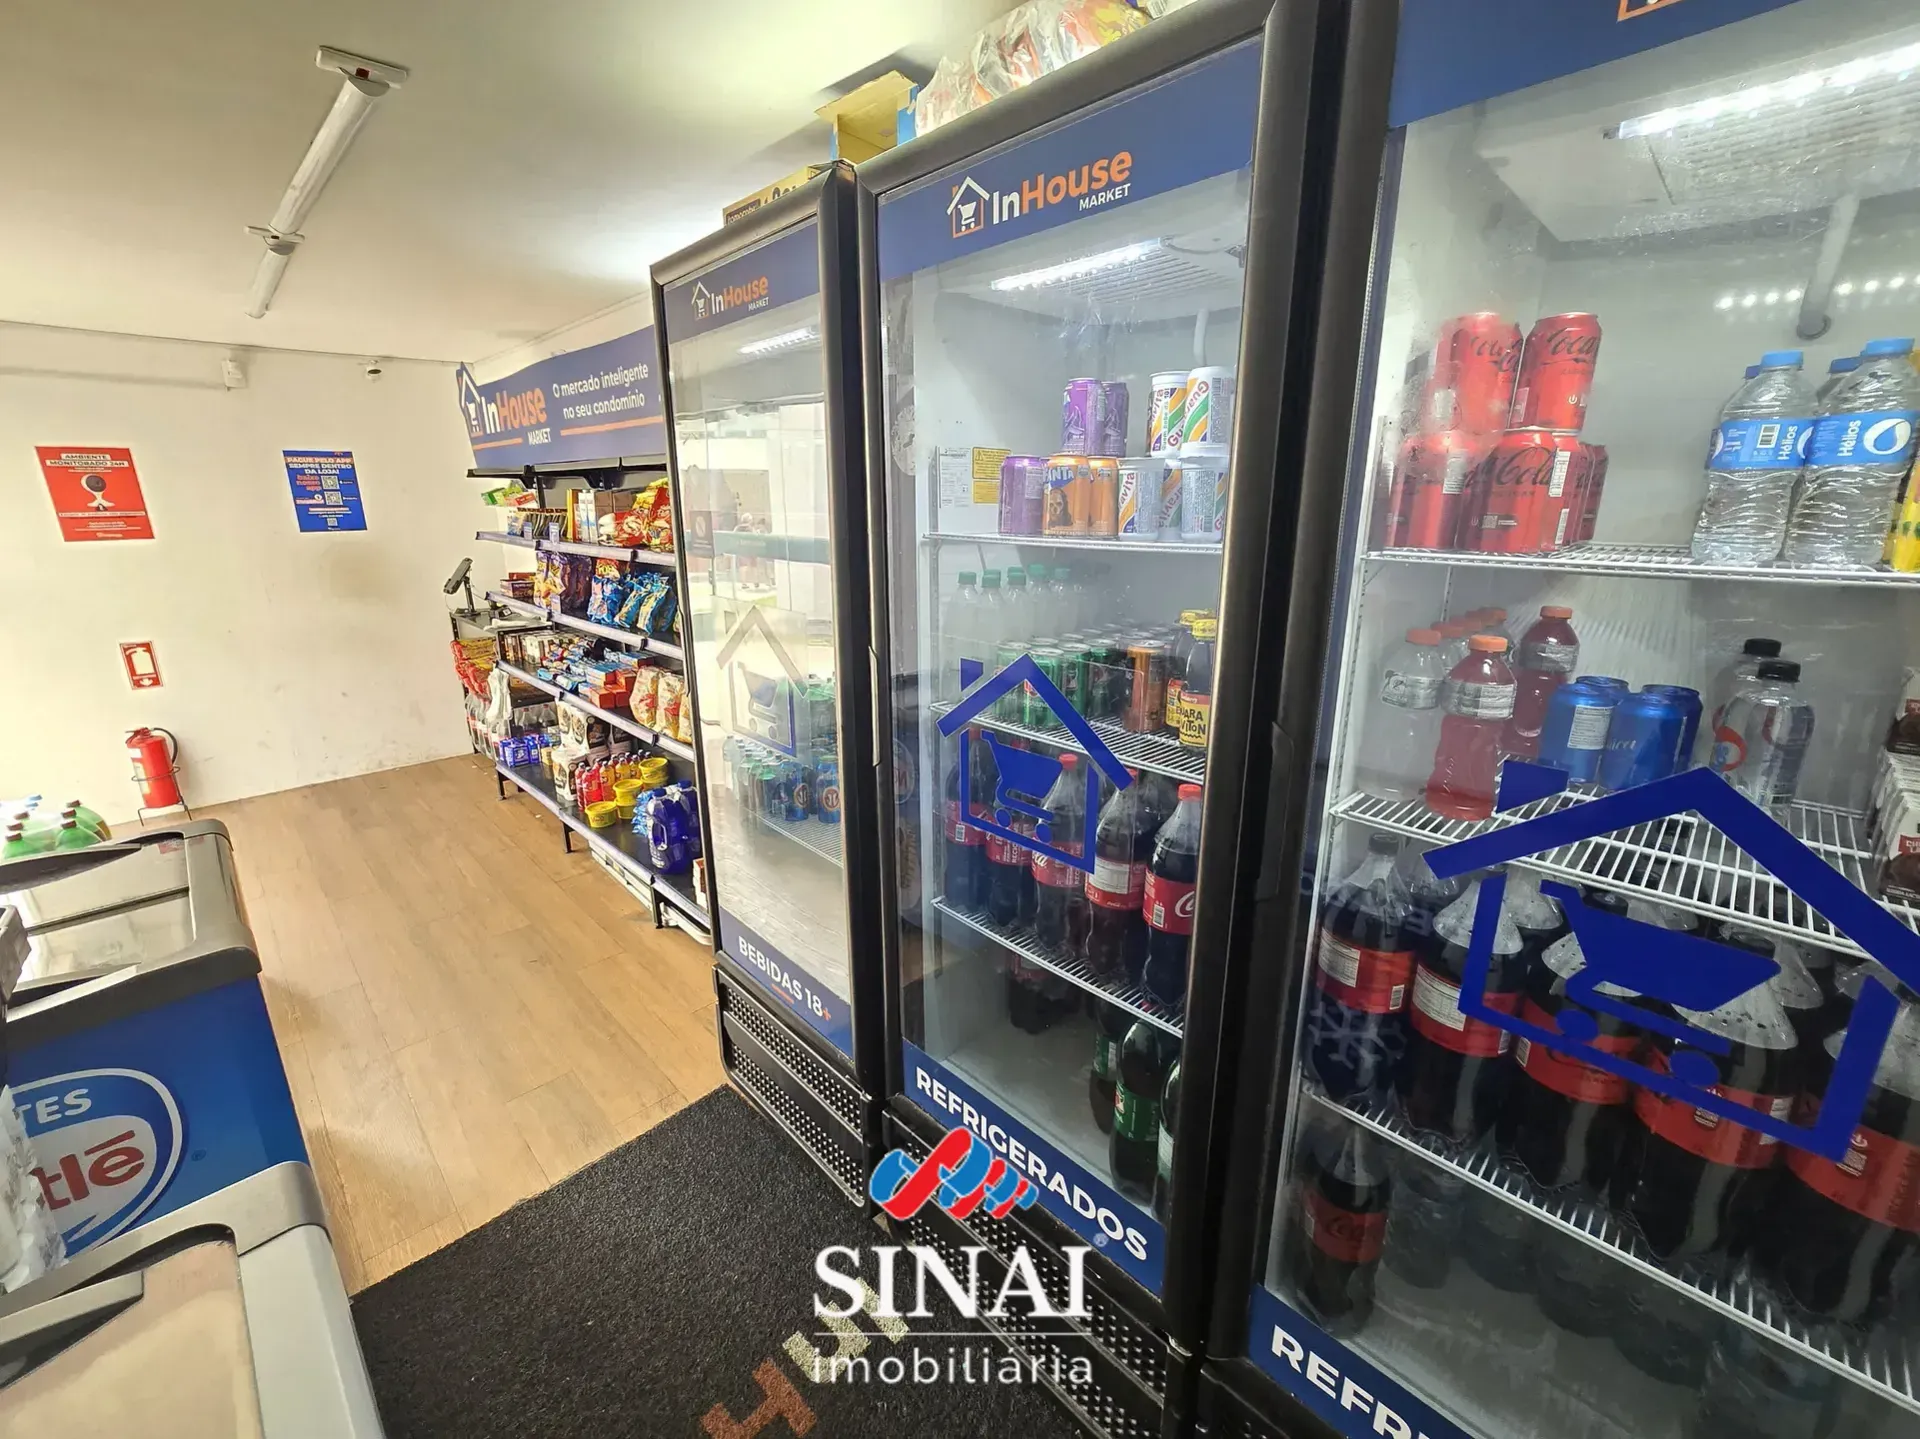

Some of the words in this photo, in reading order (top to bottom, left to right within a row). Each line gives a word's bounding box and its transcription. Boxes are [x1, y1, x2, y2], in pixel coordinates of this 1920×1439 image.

[992, 150, 1133, 225] InHouse
[1078, 183, 1132, 211] MARKET
[711, 276, 769, 315] InHouse
[748, 297, 769, 311] MARKET
[552, 383, 561, 399] O
[561, 374, 600, 398] mercado
[600, 363, 649, 389] inteligente
[481, 388, 548, 435] InHouse
[563, 405, 575, 420] no
[576, 403, 593, 418] seu
[593, 389, 645, 414] condomínio
[528, 428, 551, 446] MARKET
[738, 935, 803, 1001] BEBIDAS
[915, 1065, 1148, 1261] REFRIGERADOS
[1270, 1324, 1431, 1439] REFR
